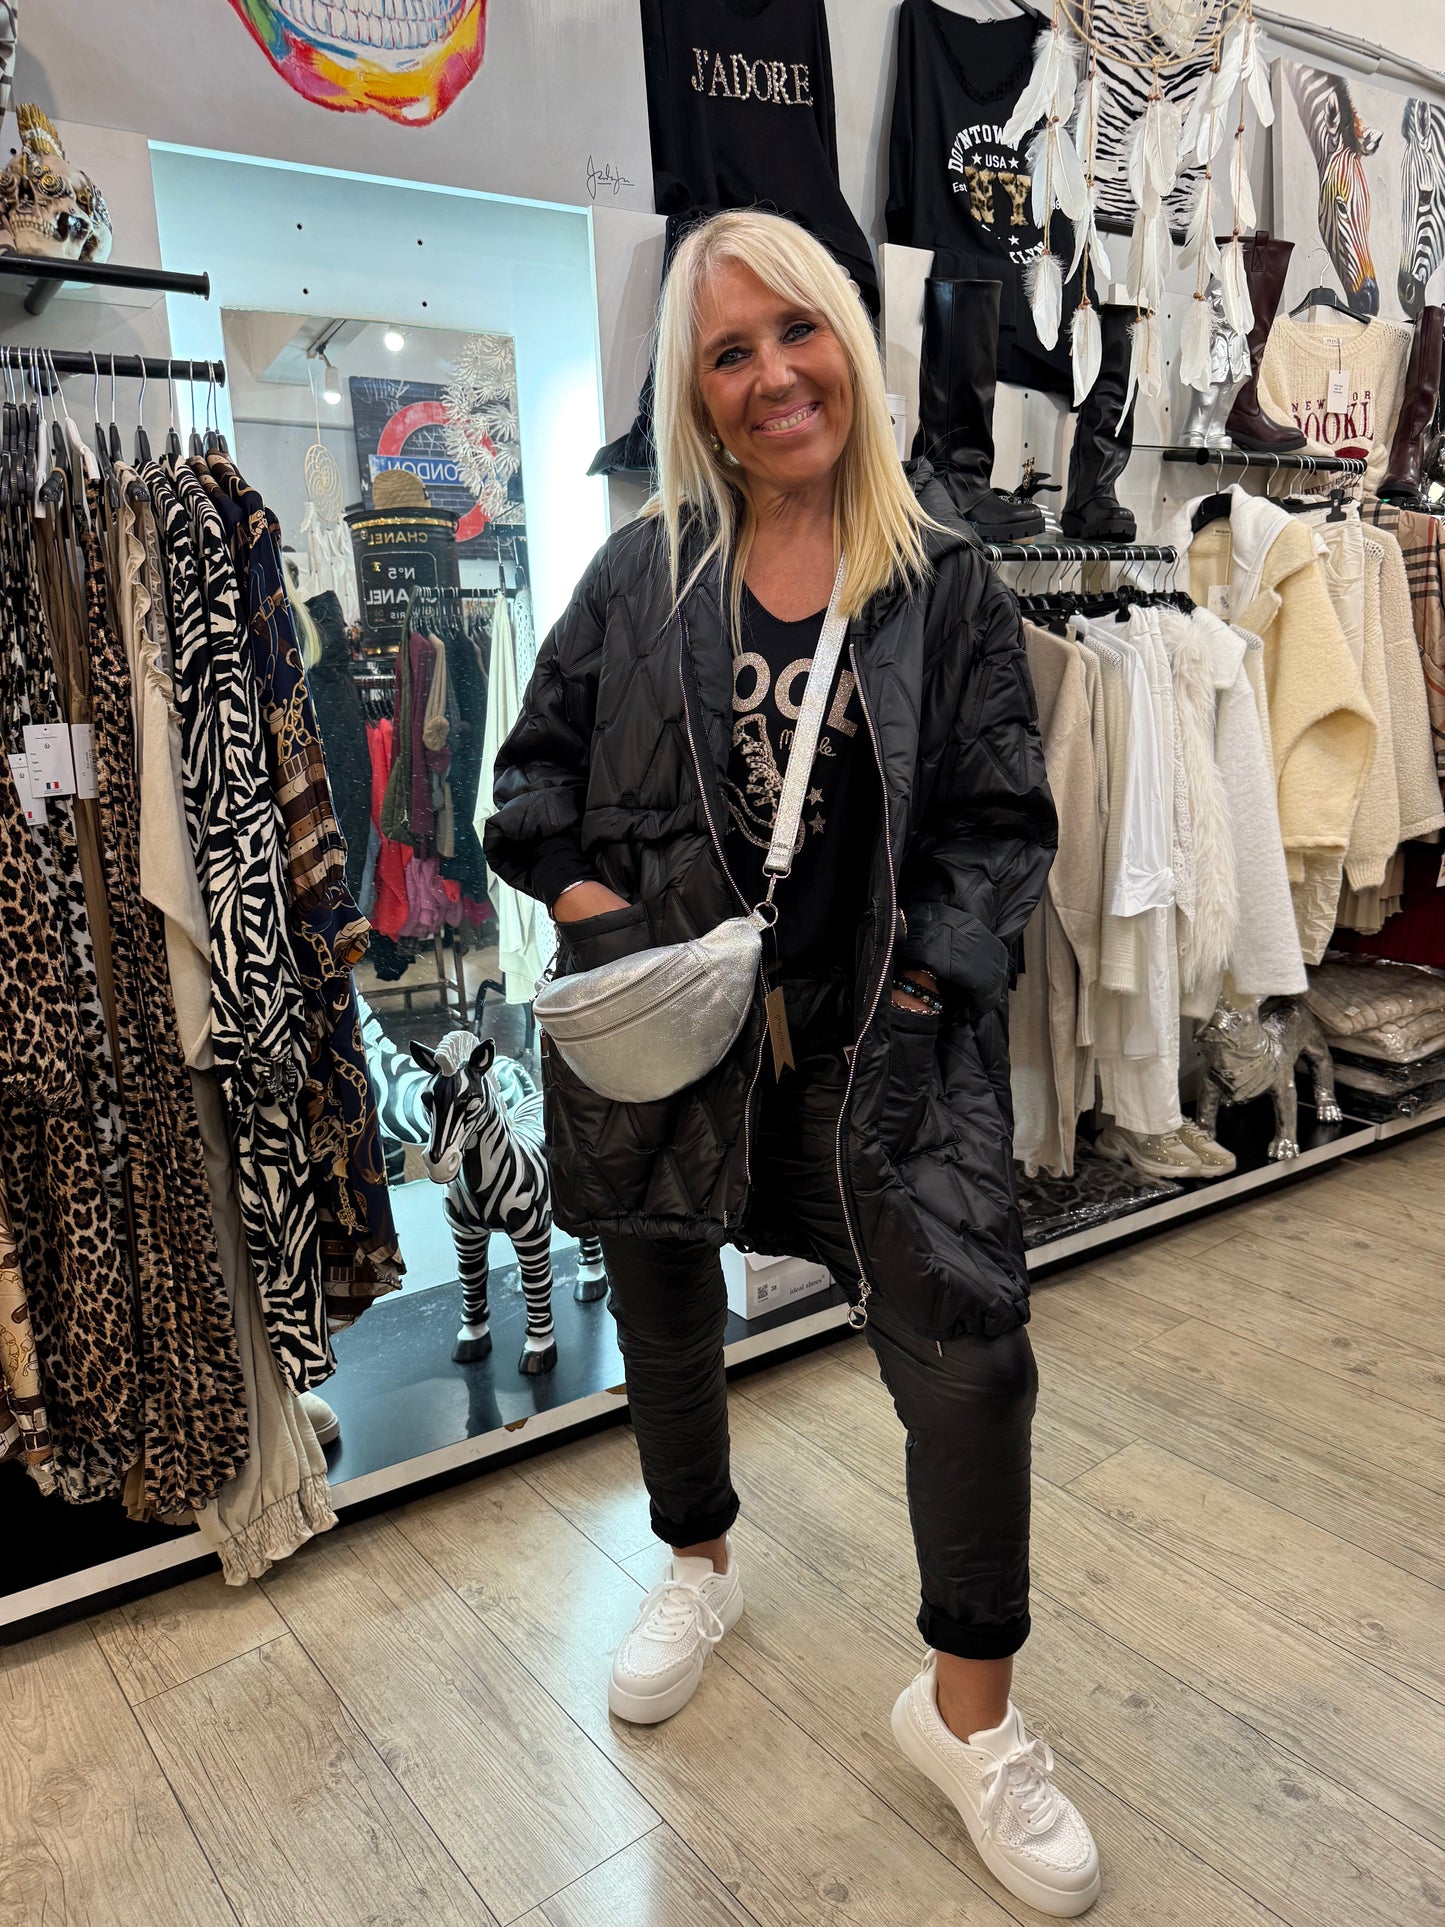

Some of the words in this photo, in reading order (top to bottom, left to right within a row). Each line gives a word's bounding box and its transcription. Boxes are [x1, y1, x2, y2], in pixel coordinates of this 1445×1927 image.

[691, 47, 814, 107] J'ADORE
[985, 154, 1008, 169] USA
[952, 181, 969, 193] Est
[1291, 398, 1326, 413] NEW
[1352, 390, 1372, 402] OR
[1293, 401, 1374, 446] OOKL
